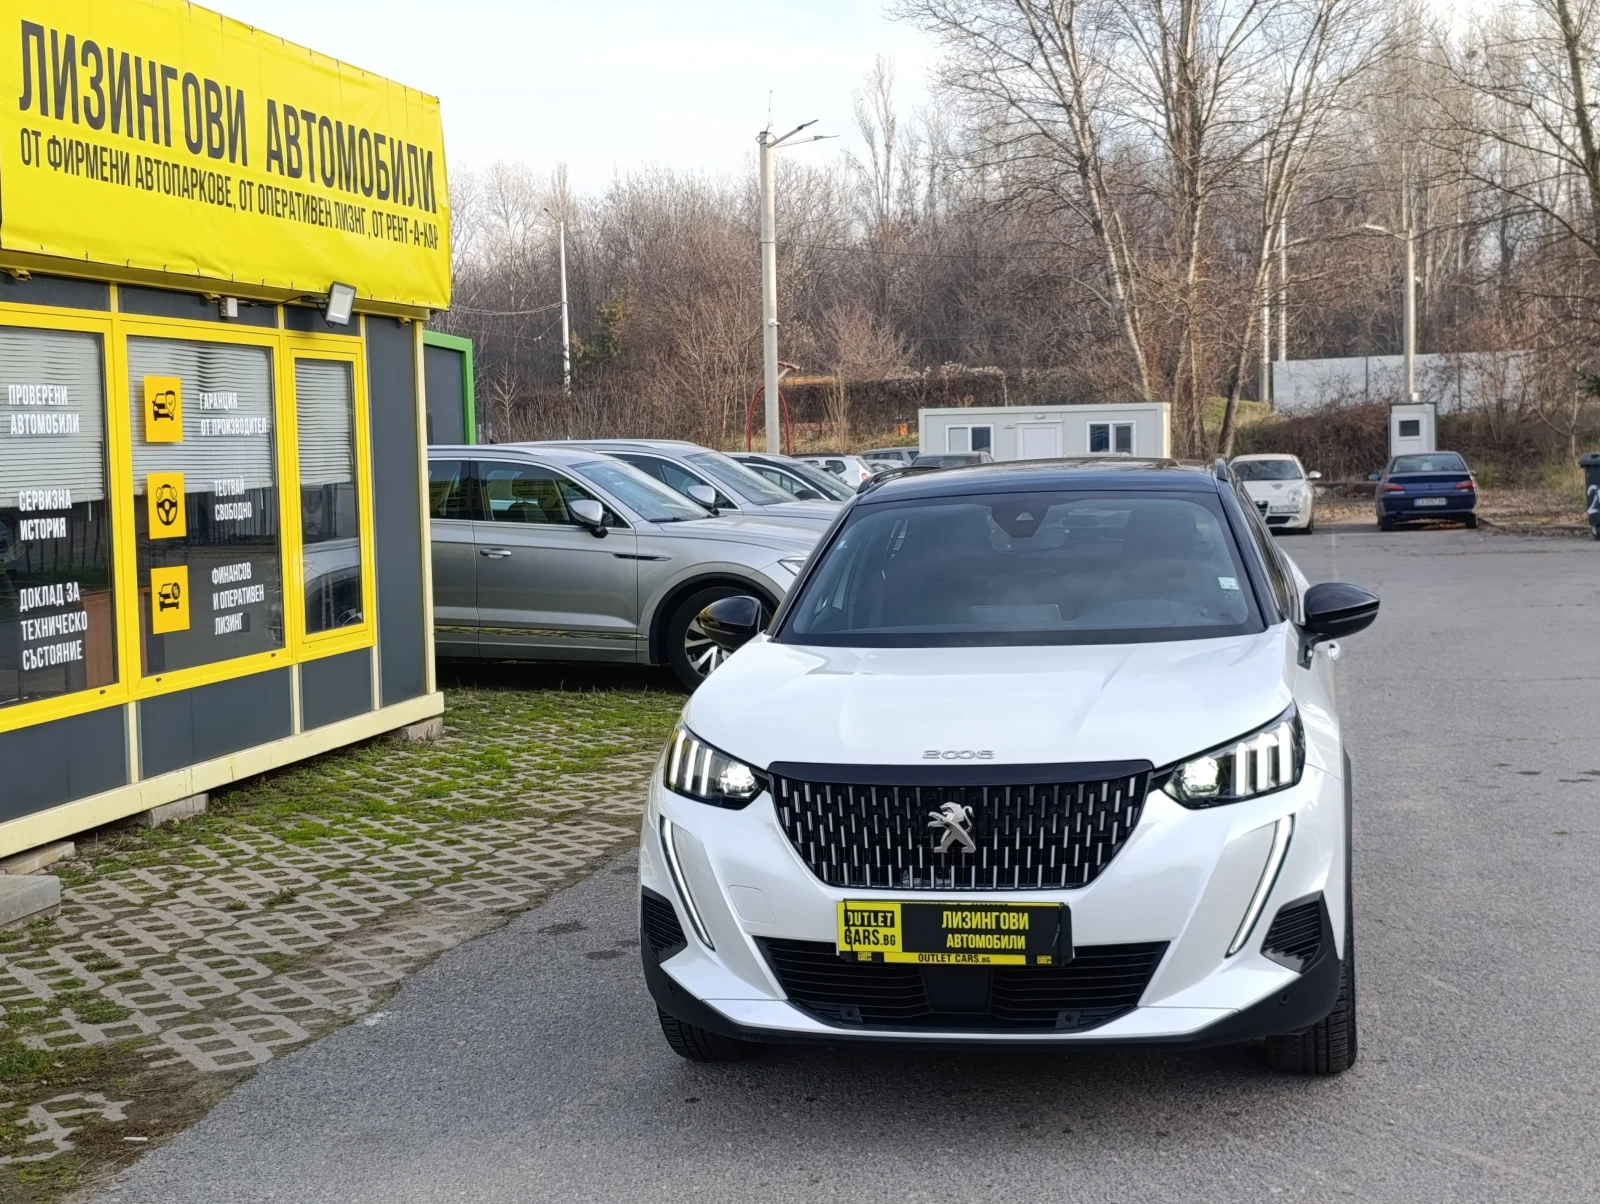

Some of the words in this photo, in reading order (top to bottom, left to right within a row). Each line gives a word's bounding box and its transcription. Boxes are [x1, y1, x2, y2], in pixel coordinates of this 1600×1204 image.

[19, 19, 249, 167] ЛИЗИНГОВИ
[266, 98, 438, 215] АВТОМОБИЛИ
[20, 127, 42, 168] ОТ
[47, 134, 131, 187] ФИРМЕНИ
[135, 154, 237, 214] АВТОПАРКОВЕ,
[238, 179, 255, 213] ОТ
[258, 183, 333, 229] ОПЕРАТИВЕН
[372, 210, 384, 239] ОТ
[386, 212, 439, 251] РЕНТ-А-КАР
[8, 384, 69, 406] ПРОВЕРЕНИ
[199, 392, 238, 411] ГАРАНЦИЯ
[10, 413, 80, 435] АВТОМОБИЛИ
[201, 418, 211, 436] ОТ
[211, 417, 267, 436] ПРОИЗВОДИТЕЛ
[213, 475, 245, 497] ТЕСТВАЙ
[18, 489, 73, 512] СЕРВИЗНА
[214, 501, 252, 521] СВОБОДНО
[19, 517, 67, 541] ИСТОРИЯ
[211, 562, 252, 585] ФИНАНСОВ
[20, 584, 65, 613] ДОКЛАД
[66, 581, 81, 603] ЗА
[212, 592, 220, 611] И
[219, 584, 265, 609] ОПЕРАТИВЕН
[20, 610, 88, 642] ТЕХНИЧЕСКО
[214, 612, 244, 636] ЛИЗИНГ
[22, 639, 83, 671] СЪСТОЯНИЕ
[921, 749, 996, 760] 2008
[941, 911, 1029, 930] ЛИЗИНГОВИ
[946, 934, 1025, 949] АВТОМОБИЛИ
[917, 953, 952, 963] OUTLET
[954, 954, 991, 964] CARS.BG
